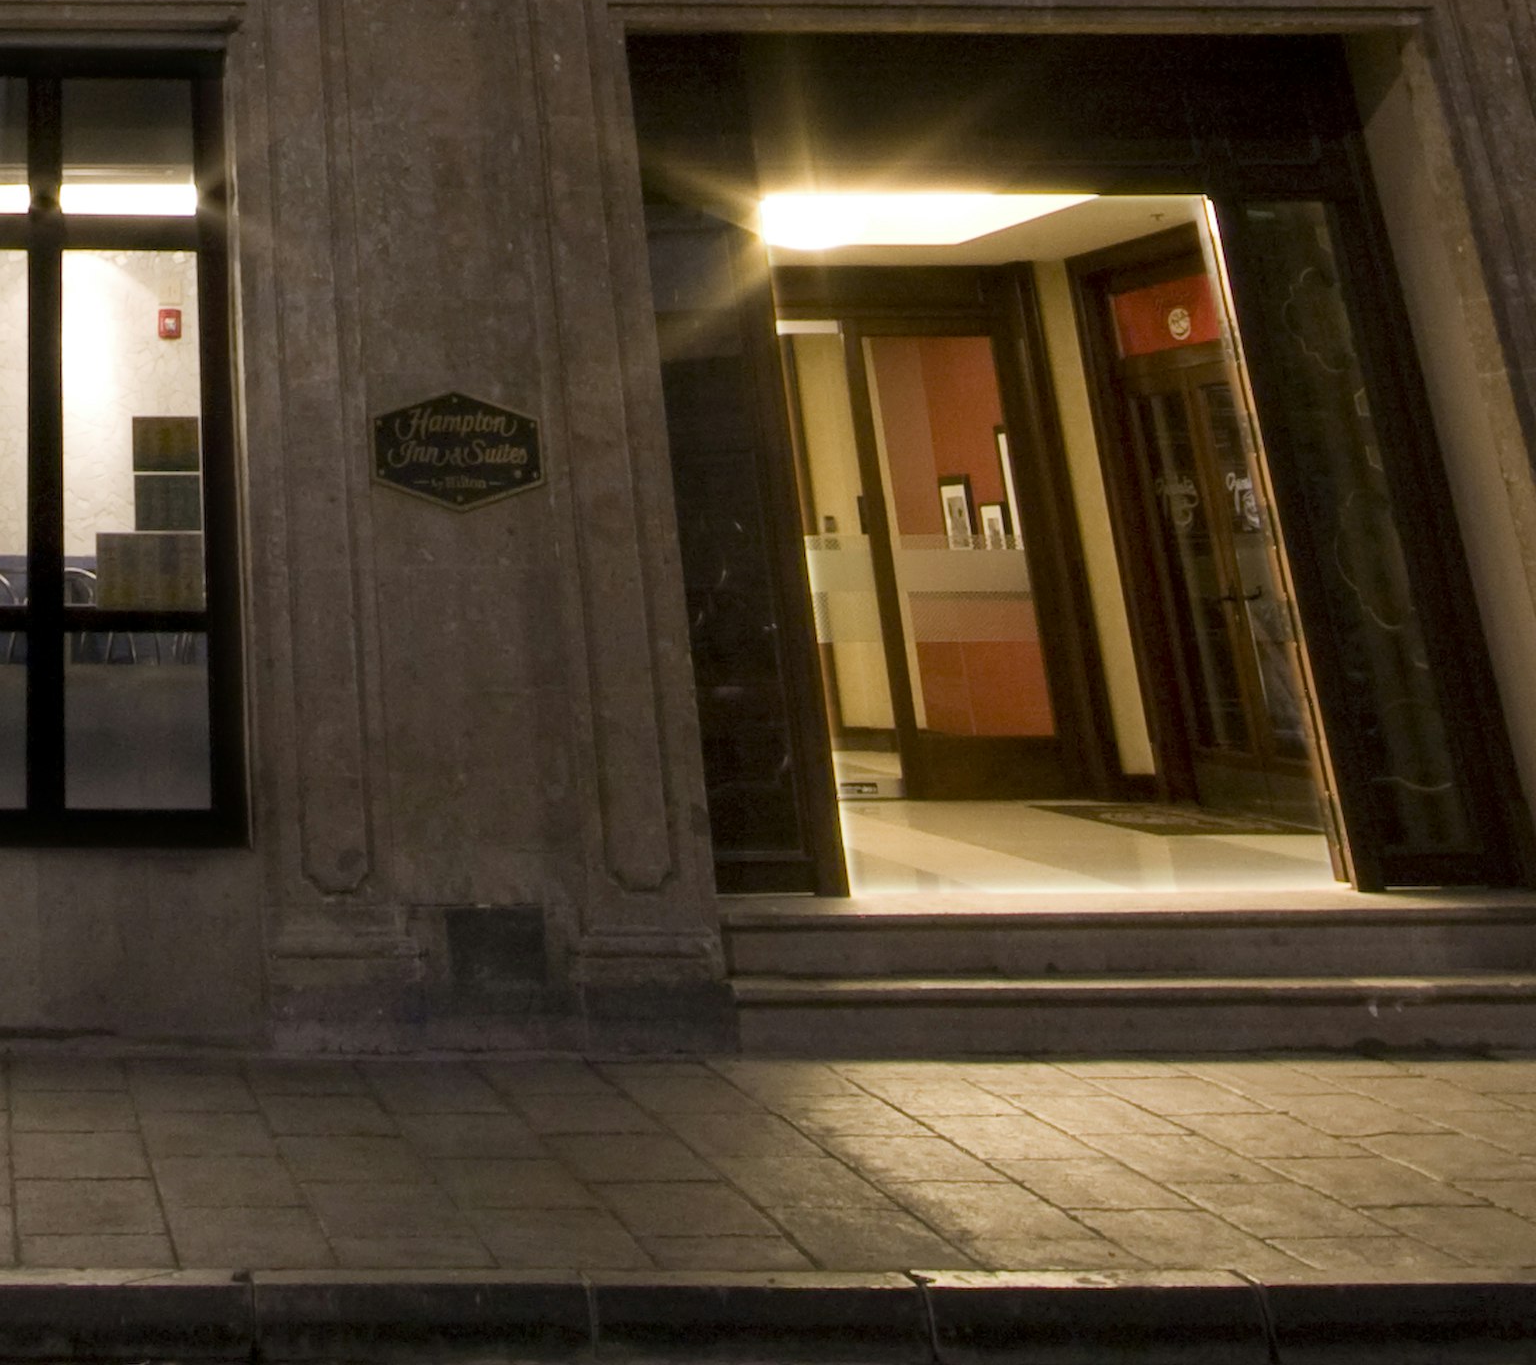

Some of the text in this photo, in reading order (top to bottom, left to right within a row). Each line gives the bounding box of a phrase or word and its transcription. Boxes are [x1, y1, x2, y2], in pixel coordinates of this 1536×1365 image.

[395, 407, 518, 440] Hampton
[387, 439, 528, 468] Inn & Suites
